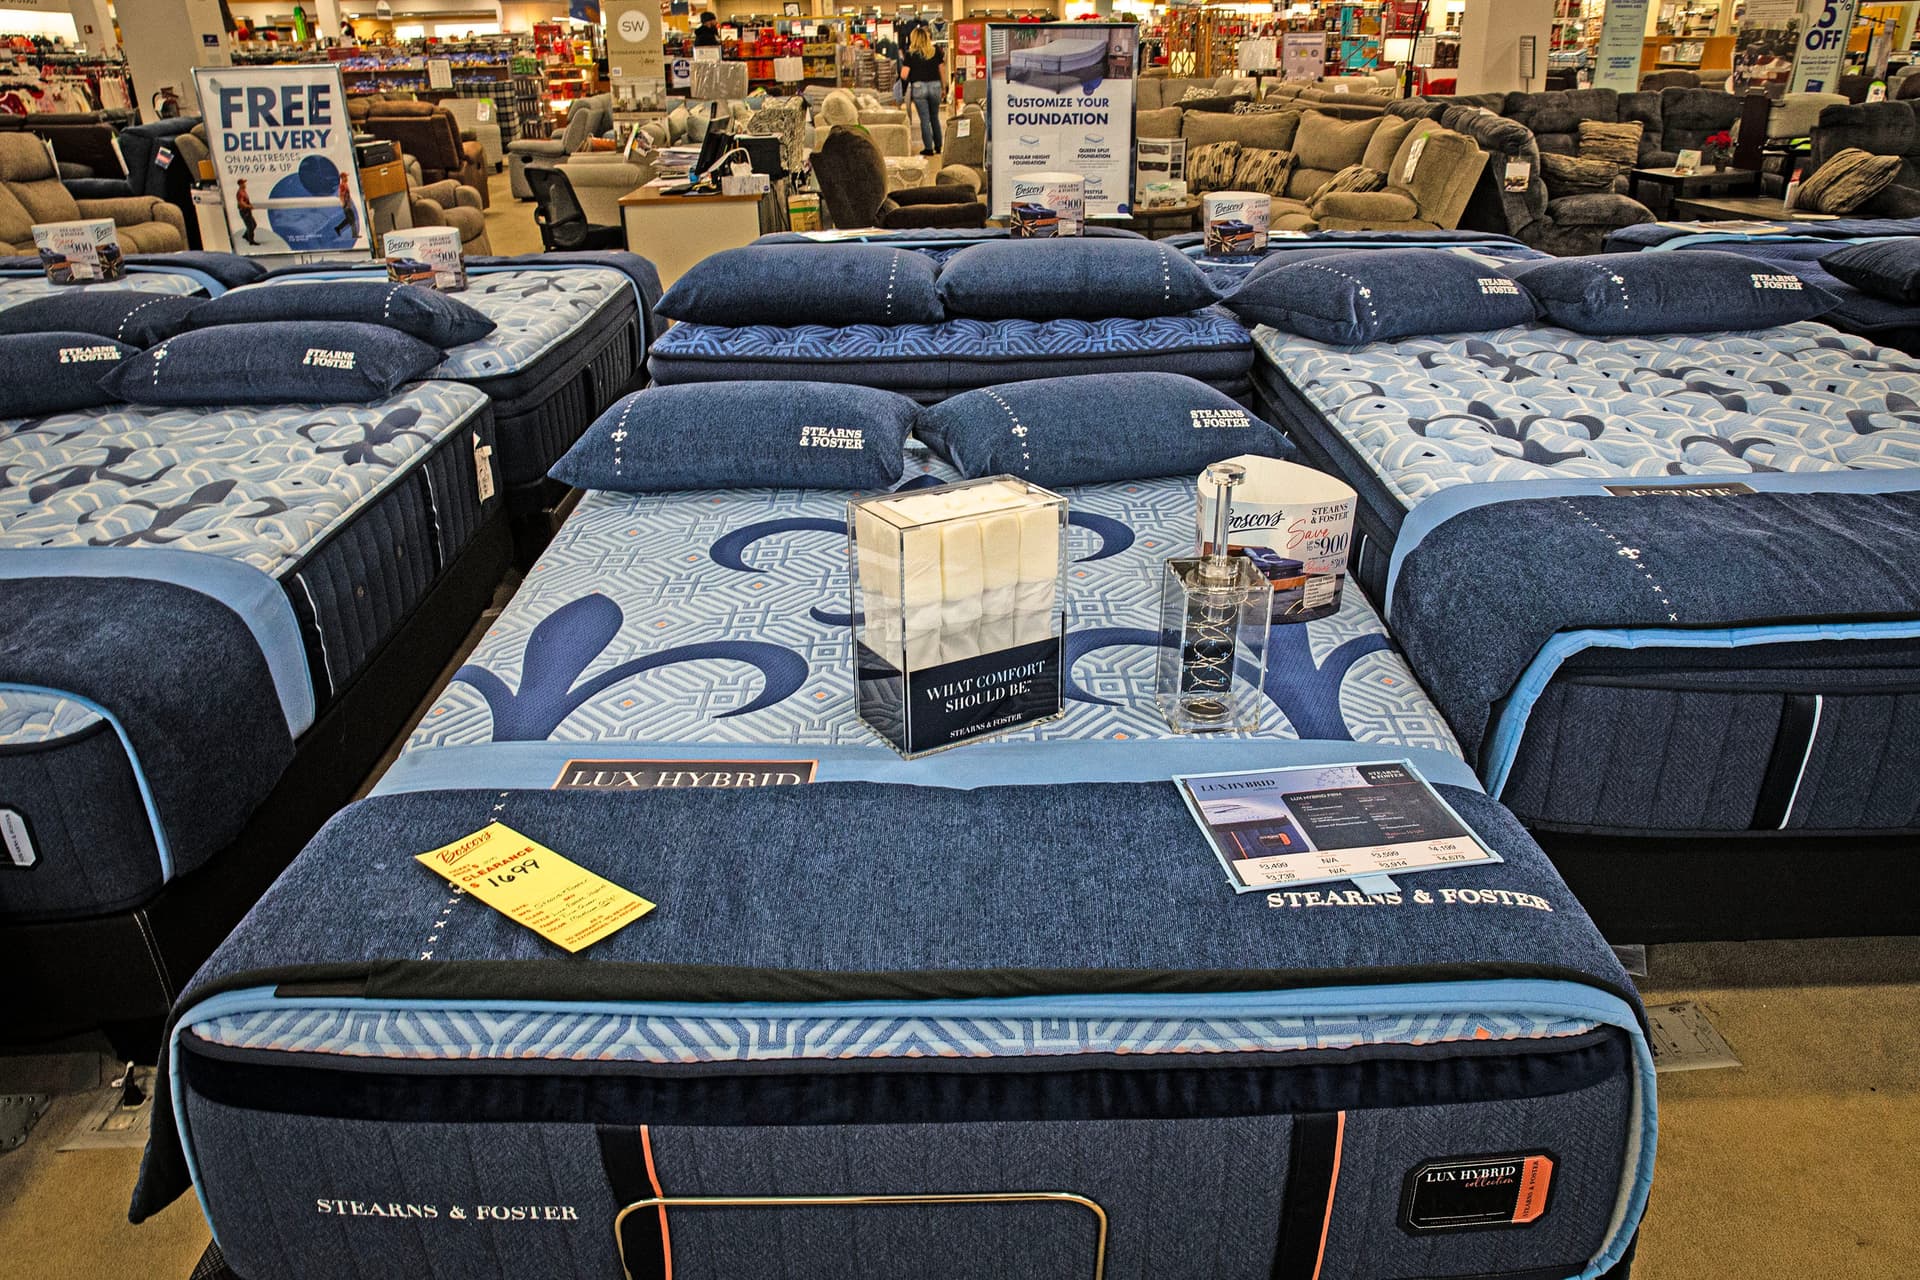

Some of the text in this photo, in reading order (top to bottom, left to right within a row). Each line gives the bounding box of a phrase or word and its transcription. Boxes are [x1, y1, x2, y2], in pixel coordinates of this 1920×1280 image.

[622, 21, 645, 32] SW
[1805, 30, 1842, 50] OFF
[220, 84, 332, 128] FREE
[1007, 97, 1109, 108] CUSTOMIZE YOUR
[1007, 113, 1109, 125] FOUNDATION
[224, 129, 331, 152] DELIVERY
[225, 152, 300, 164] ON MATTRESSES
[227, 163, 293, 175] $799.99 & UP
[1478, 278, 1514, 287] STEARNS
[1751, 273, 1798, 283] STEARNS
[1481, 285, 1519, 295] & FOSTER
[1754, 281, 1803, 290] & FOSTER
[59, 345, 117, 356] STEARNS
[60, 351, 121, 363] & FOSTER
[307, 348, 355, 361] STEARNS
[302, 356, 356, 370] & FOSTER
[1190, 410, 1244, 420] STEARNS
[1192, 418, 1250, 428] & FOSTER
[801, 426, 862, 439] STEARNS
[800, 436, 865, 450] & FOSTER
[1312, 503, 1349, 516] STEARNS
[1310, 511, 1349, 525] & FOSTER
[1286, 519, 1330, 550] Save
[927, 660, 1045, 701] WHAT COMFORT
[945, 688, 1005, 713] SHOULD
[950, 722, 985, 738] STEARNS
[993, 713, 1022, 727] FOSTER
[568, 770, 801, 787] LUX HYBRID
[462, 846, 534, 882] CLEARANCE
[488, 858, 540, 888] 1699
[1413, 888, 1434, 904] &
[1438, 888, 1554, 912] FOSTER
[1426, 1165, 1516, 1183] LUX HYBRID
[1464, 1175, 1515, 1189] collection
[317, 1198, 579, 1221] STEARNS & FOSTER
